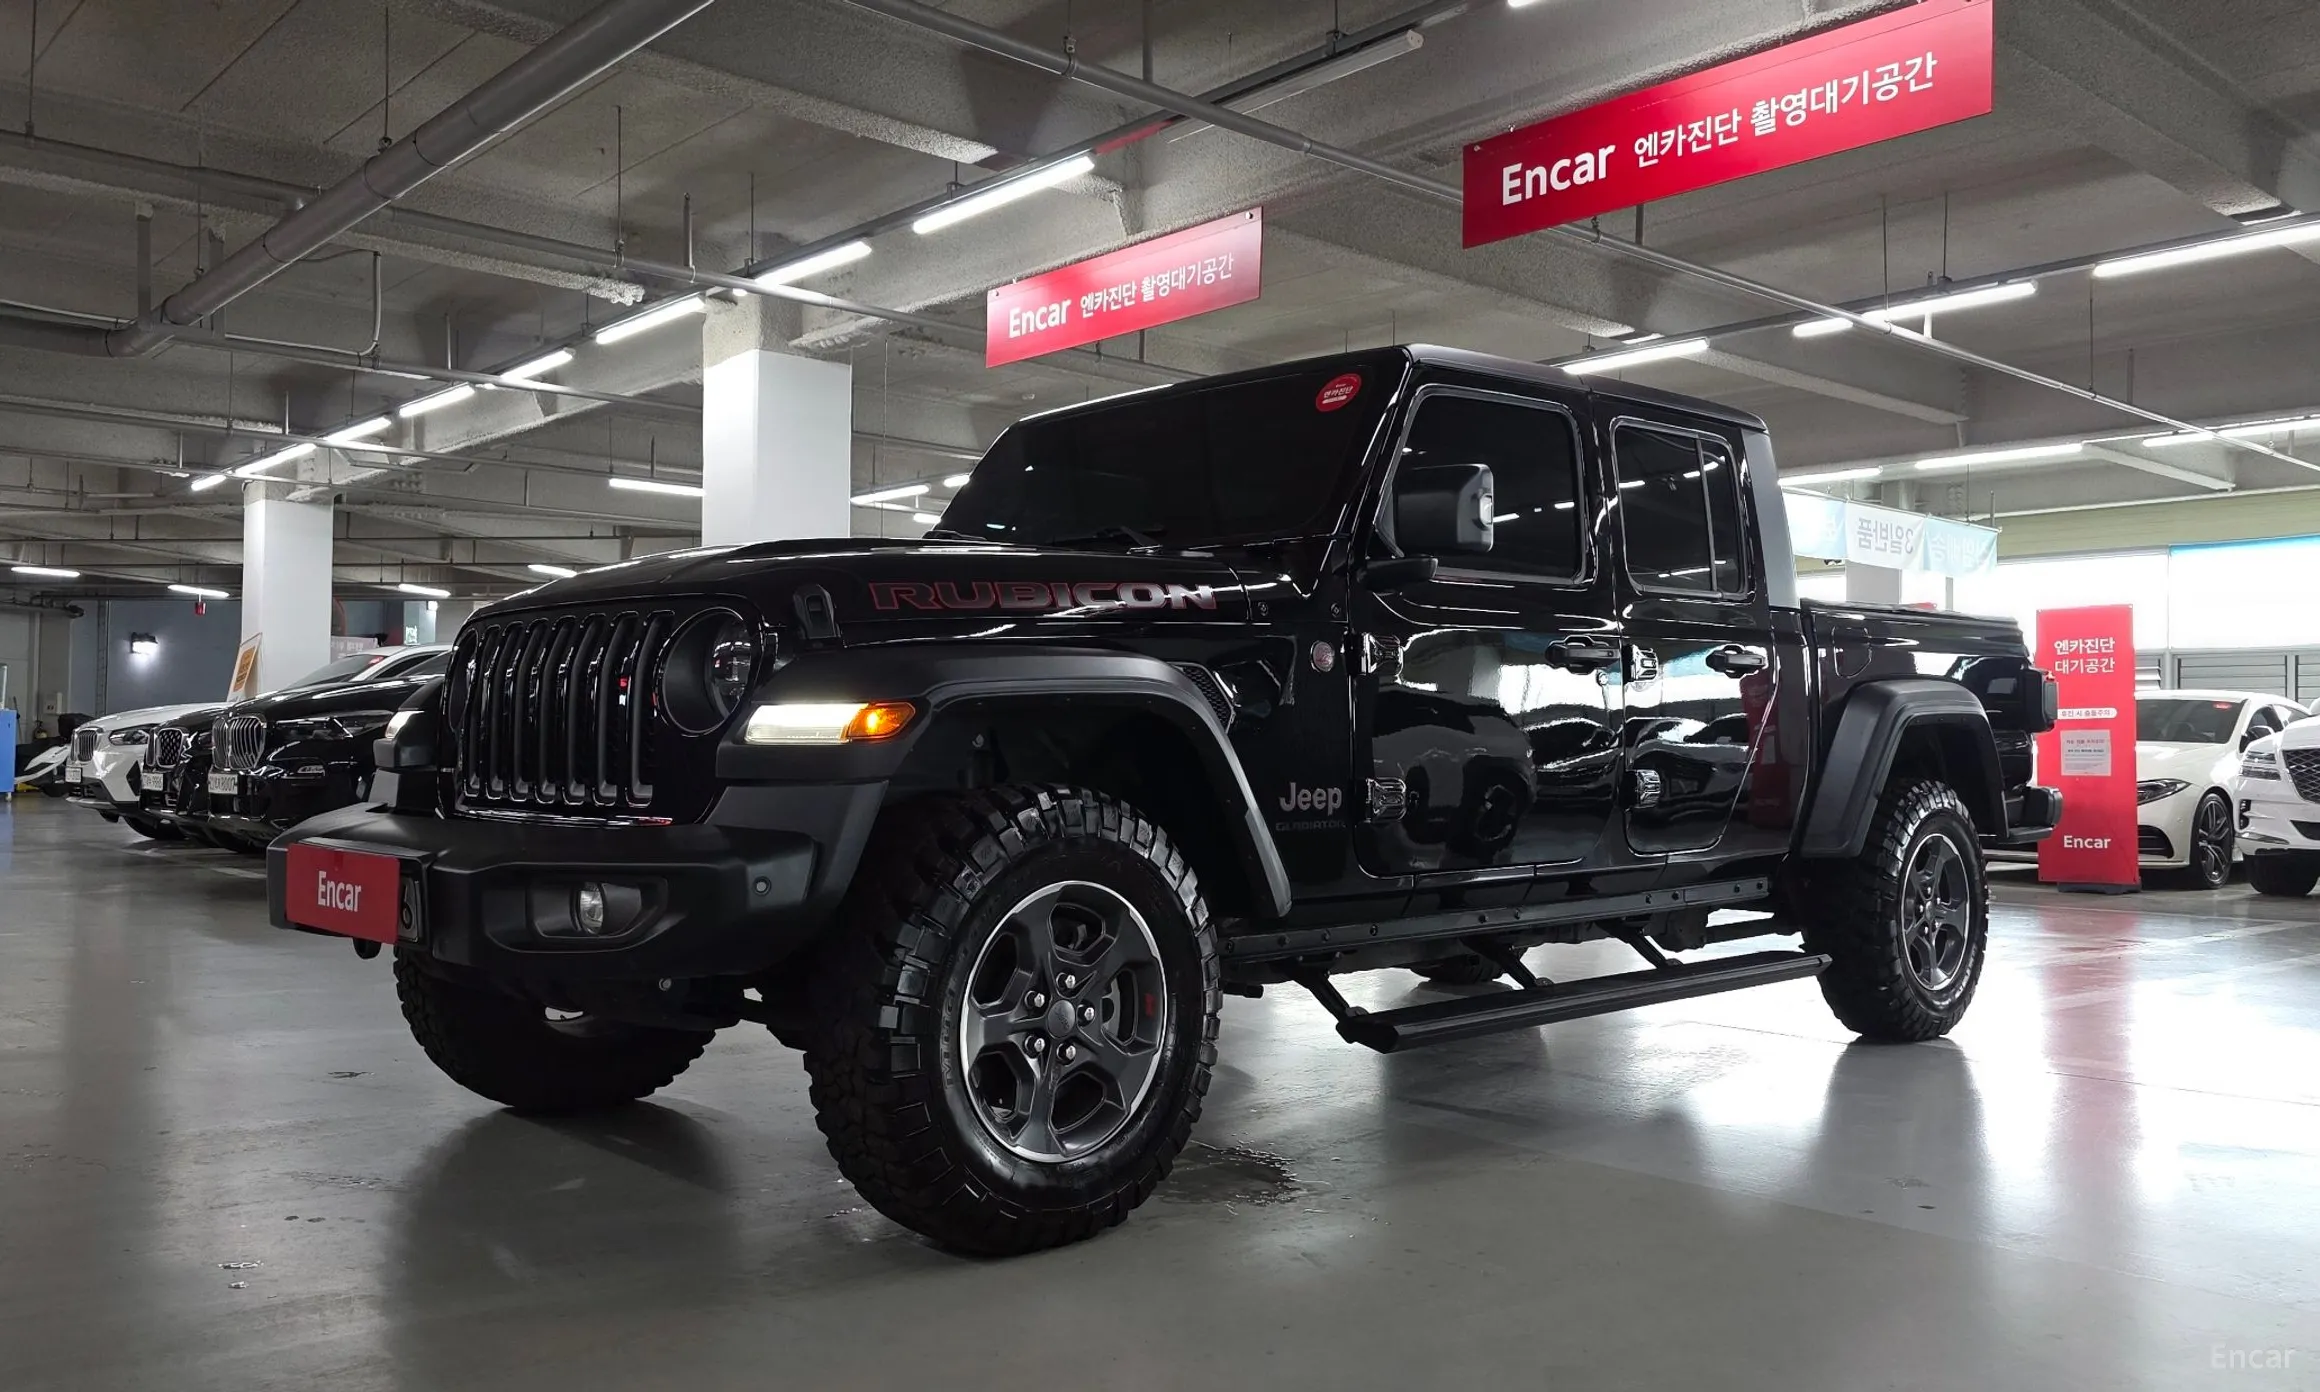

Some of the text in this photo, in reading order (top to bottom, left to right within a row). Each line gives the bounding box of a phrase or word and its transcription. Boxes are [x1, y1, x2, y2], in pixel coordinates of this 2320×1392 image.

[1502, 51, 1938, 206] Encar 엔카진단 촬영대기공간
[1008, 252, 1235, 339] Encar 엔카진단 촬영대기공간
[868, 581, 1217, 610] RUBICON
[2054, 637, 2115, 656] 엔카진단
[2054, 657, 2115, 674] 대기공간
[1279, 781, 1343, 816] Jeep
[2063, 835, 2111, 850] Encar
[317, 870, 362, 913] Encar
